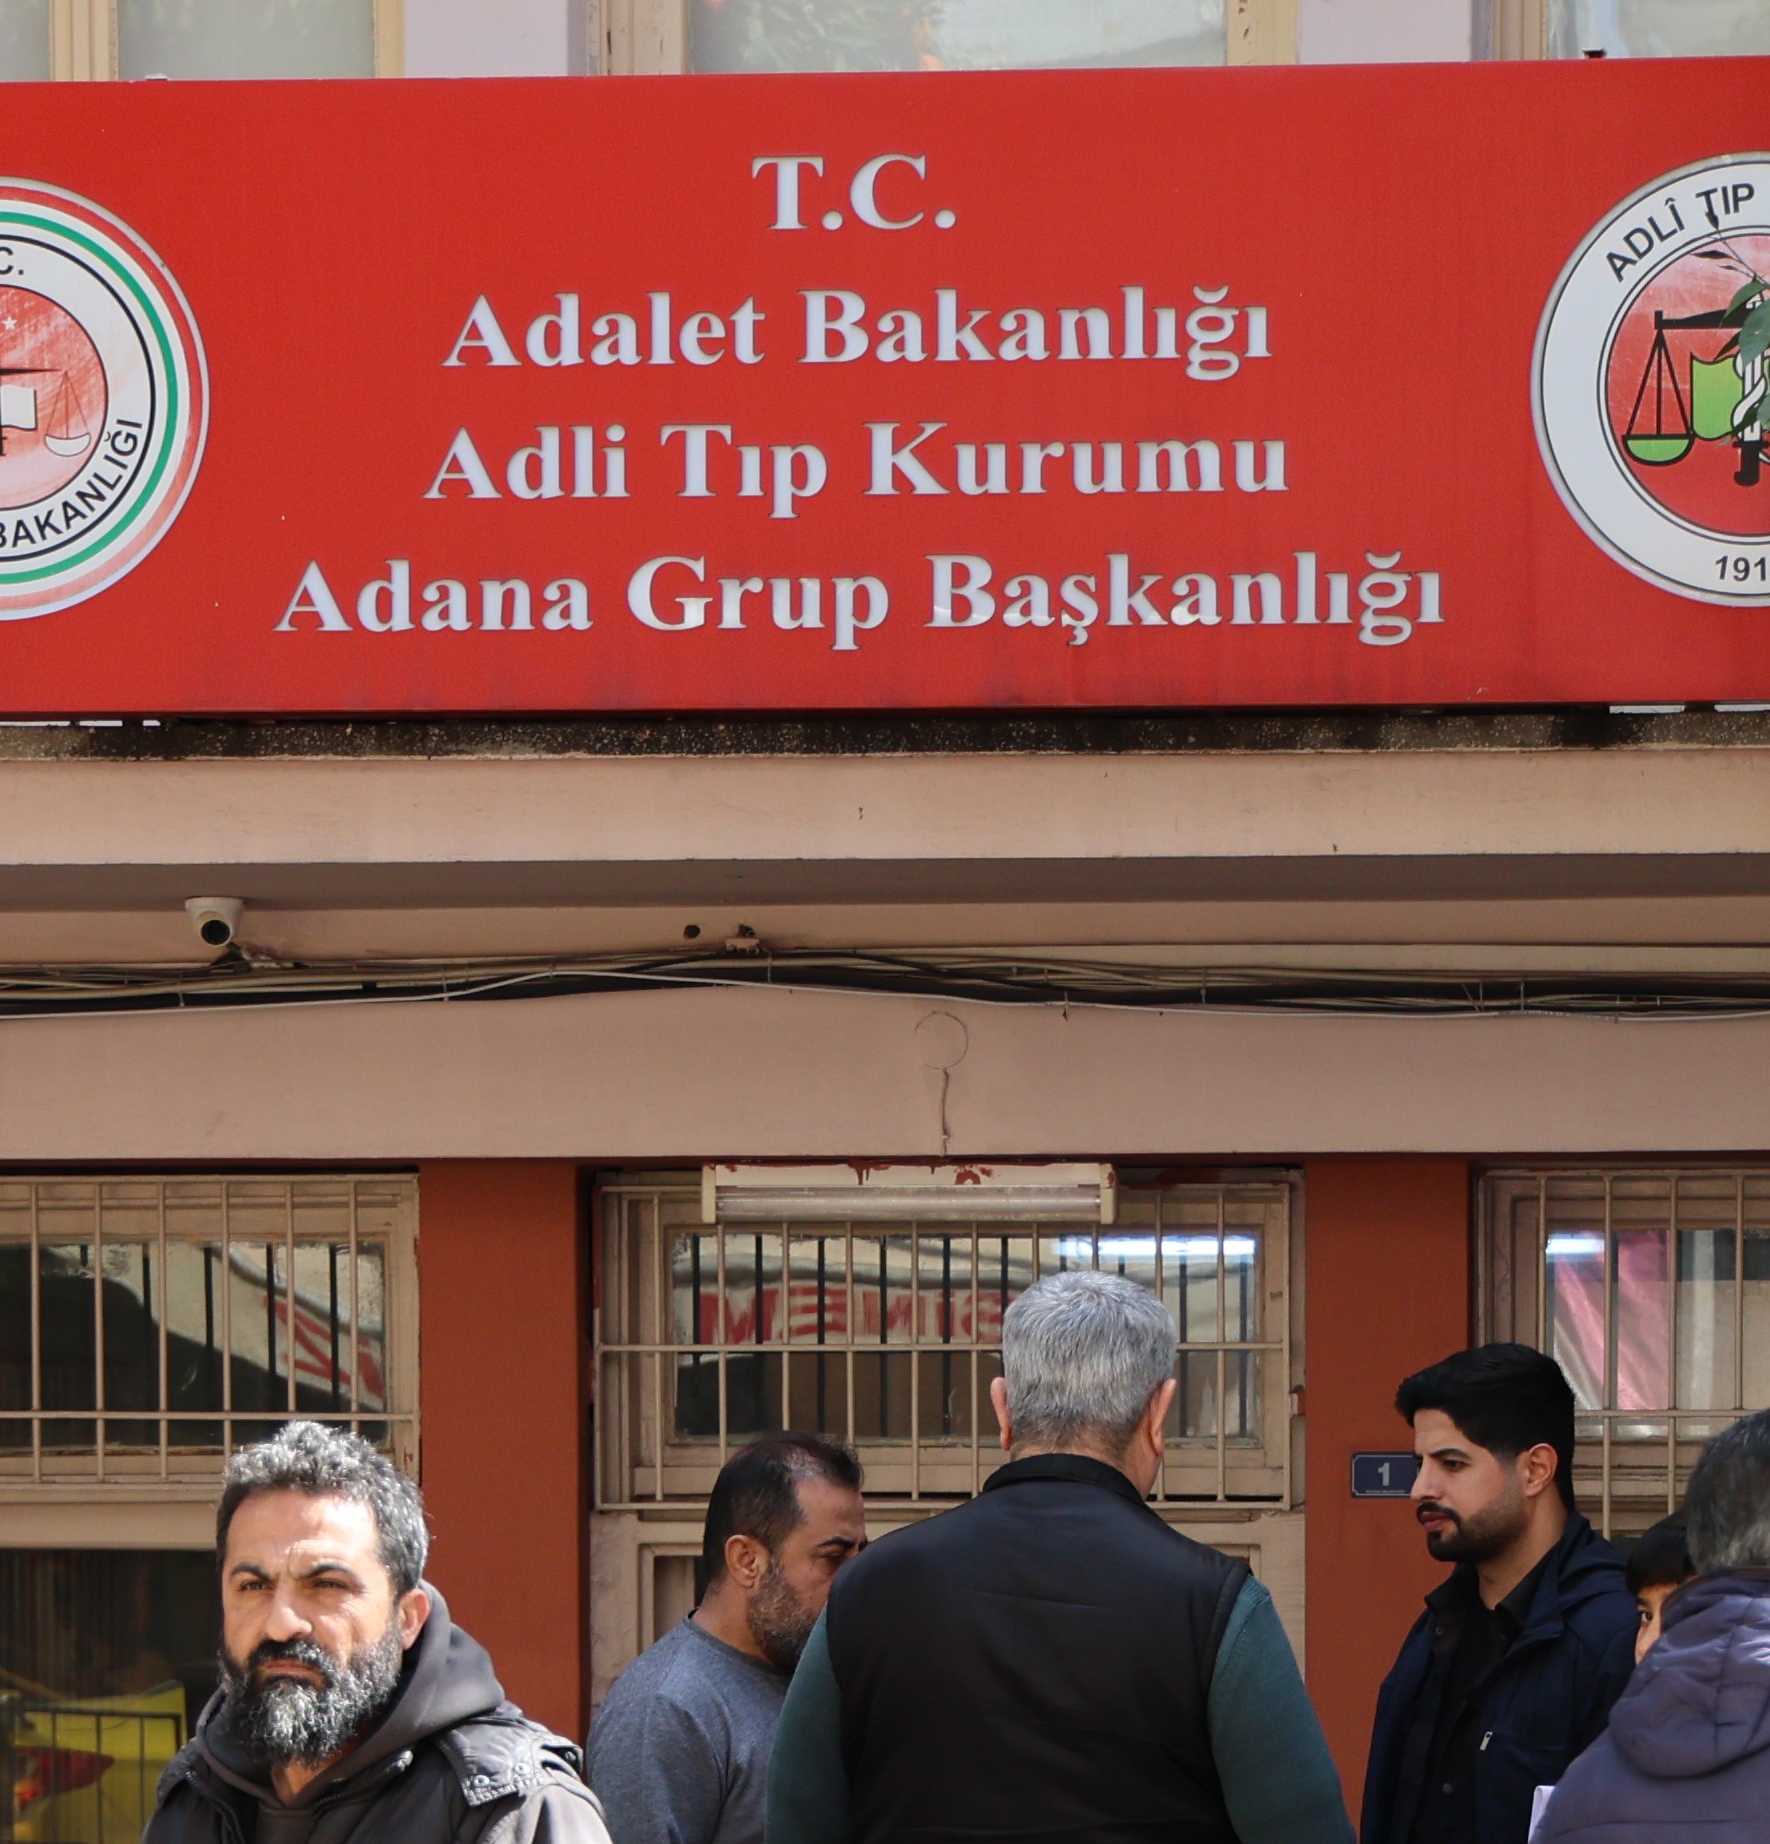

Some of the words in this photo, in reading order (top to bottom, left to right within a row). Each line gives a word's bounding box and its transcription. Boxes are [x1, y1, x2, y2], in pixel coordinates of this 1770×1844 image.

[751, 153, 957, 231] T.C.
[1604, 196, 1687, 283] ADLÎ
[1695, 182, 1755, 216] TIP
[441, 290, 767, 368] Adalet
[798, 284, 1273, 382] Bakanlığı
[422, 423, 632, 500] Adli
[659, 423, 829, 520] Tıp
[863, 421, 1290, 497] Kurumu
[272, 558, 595, 634] Adana
[626, 554, 890, 652] Grup
[923, 550, 1446, 647] Başkanlığı
[1377, 1461, 1391, 1487] 1
